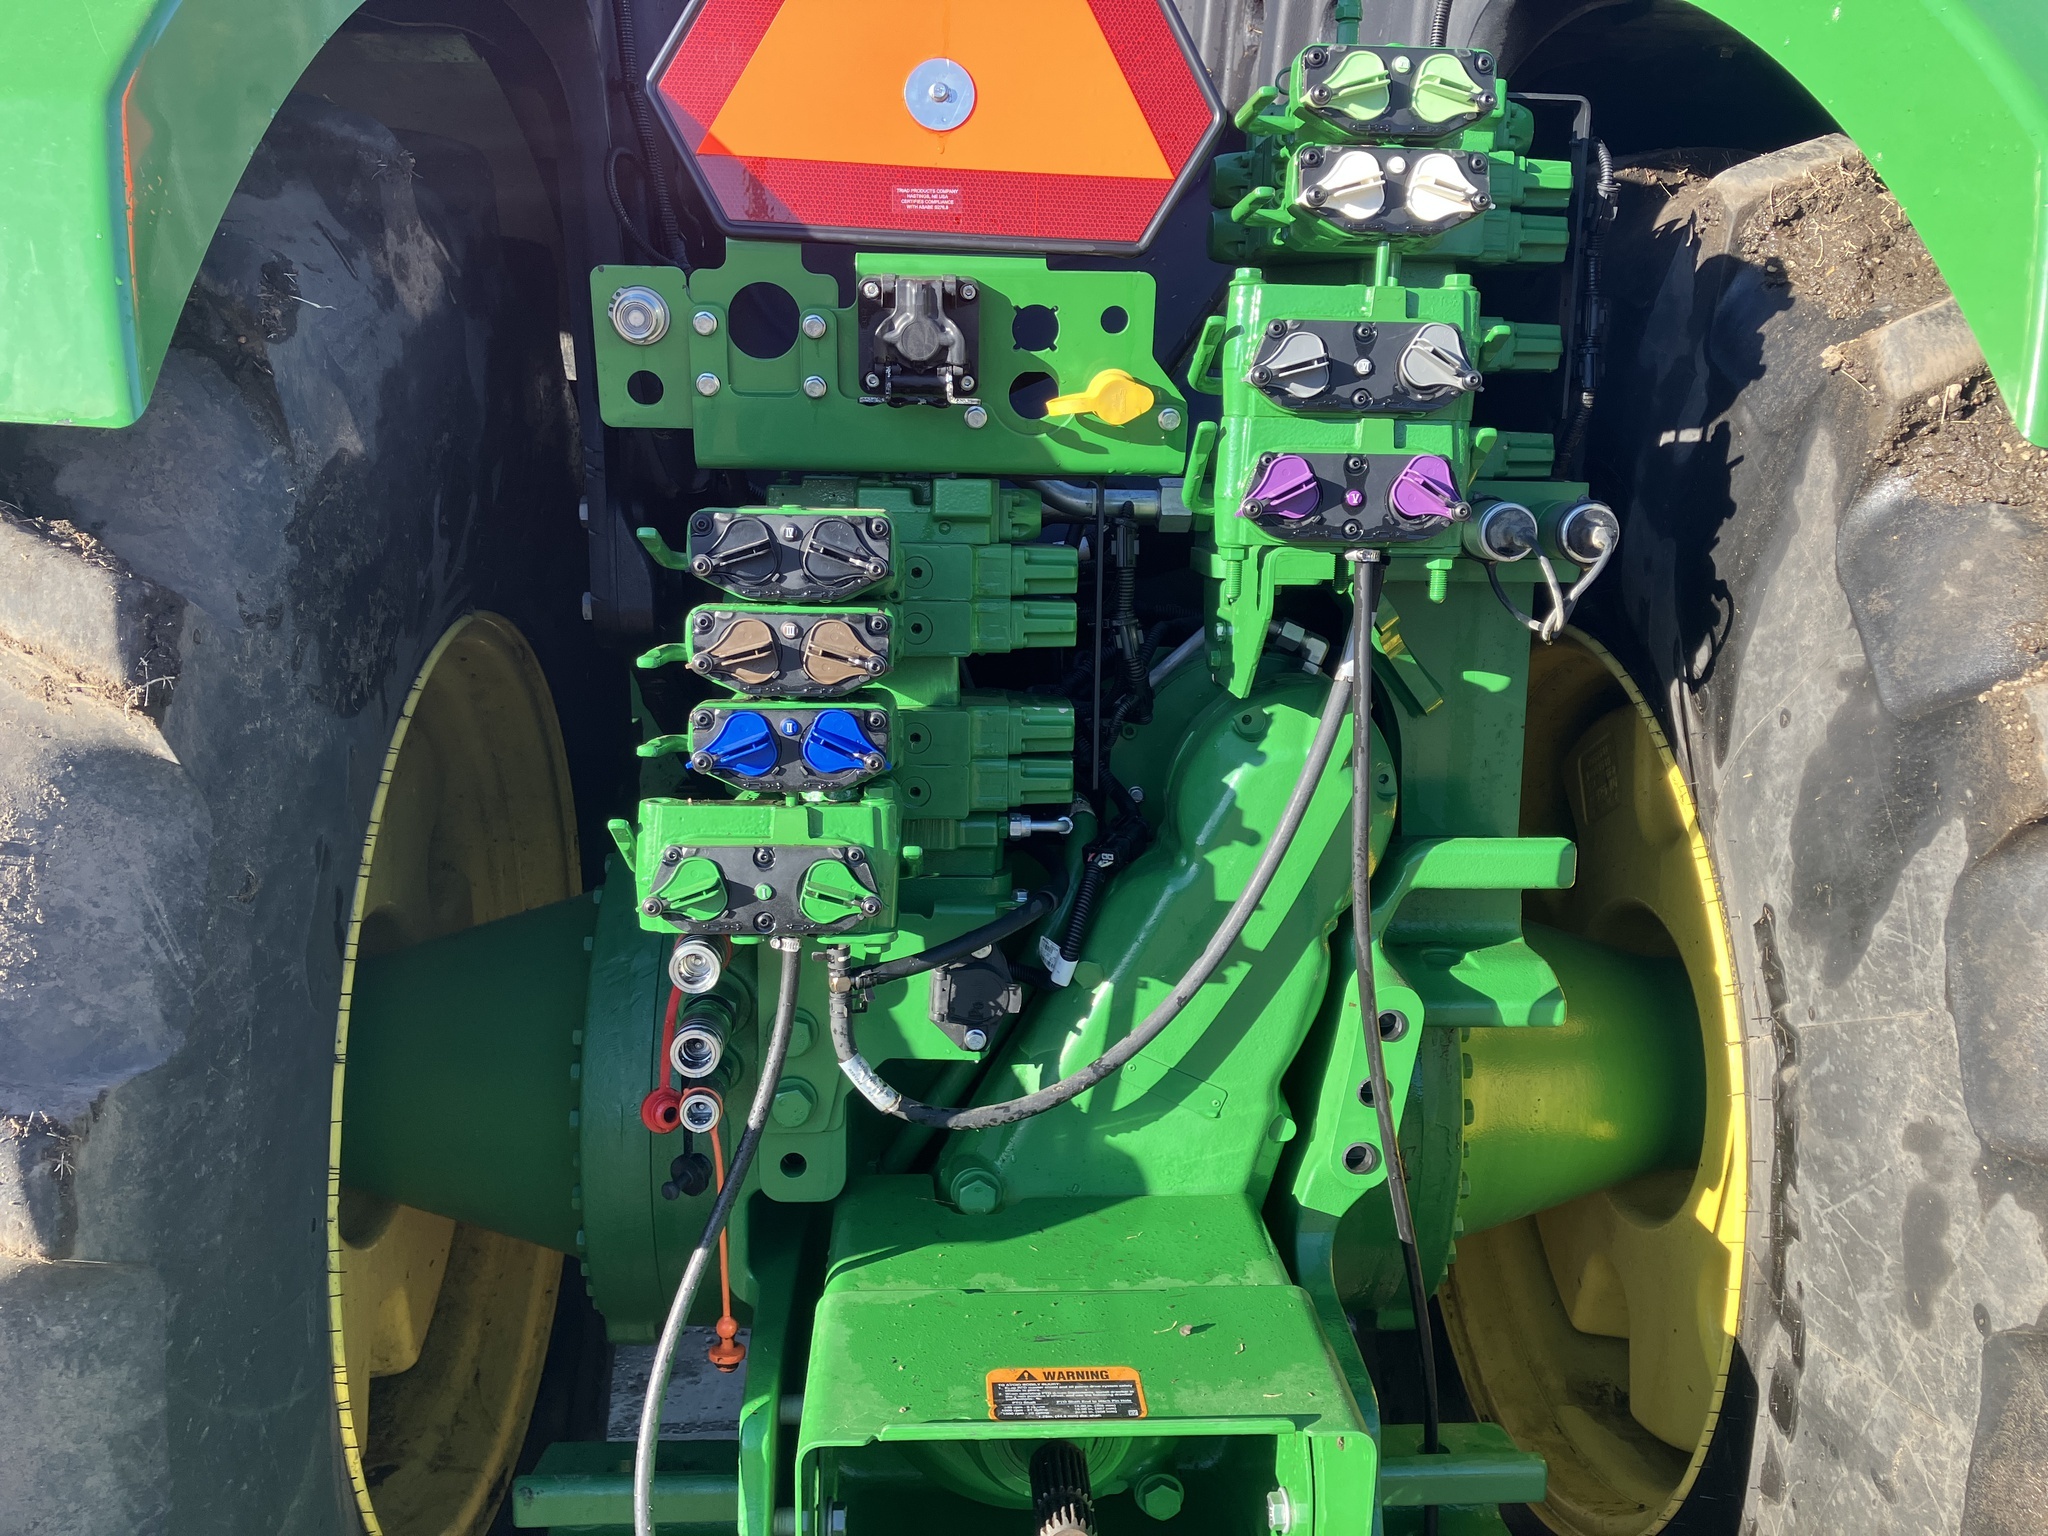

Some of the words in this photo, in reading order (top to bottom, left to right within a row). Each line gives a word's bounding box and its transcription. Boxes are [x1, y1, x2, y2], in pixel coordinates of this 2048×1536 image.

[1352, 493, 1360, 503] V
[785, 528, 794, 538] IV
[786, 625, 795, 635] III
[786, 723, 793, 733] II
[1043, 1370, 1110, 1381] WARNING
